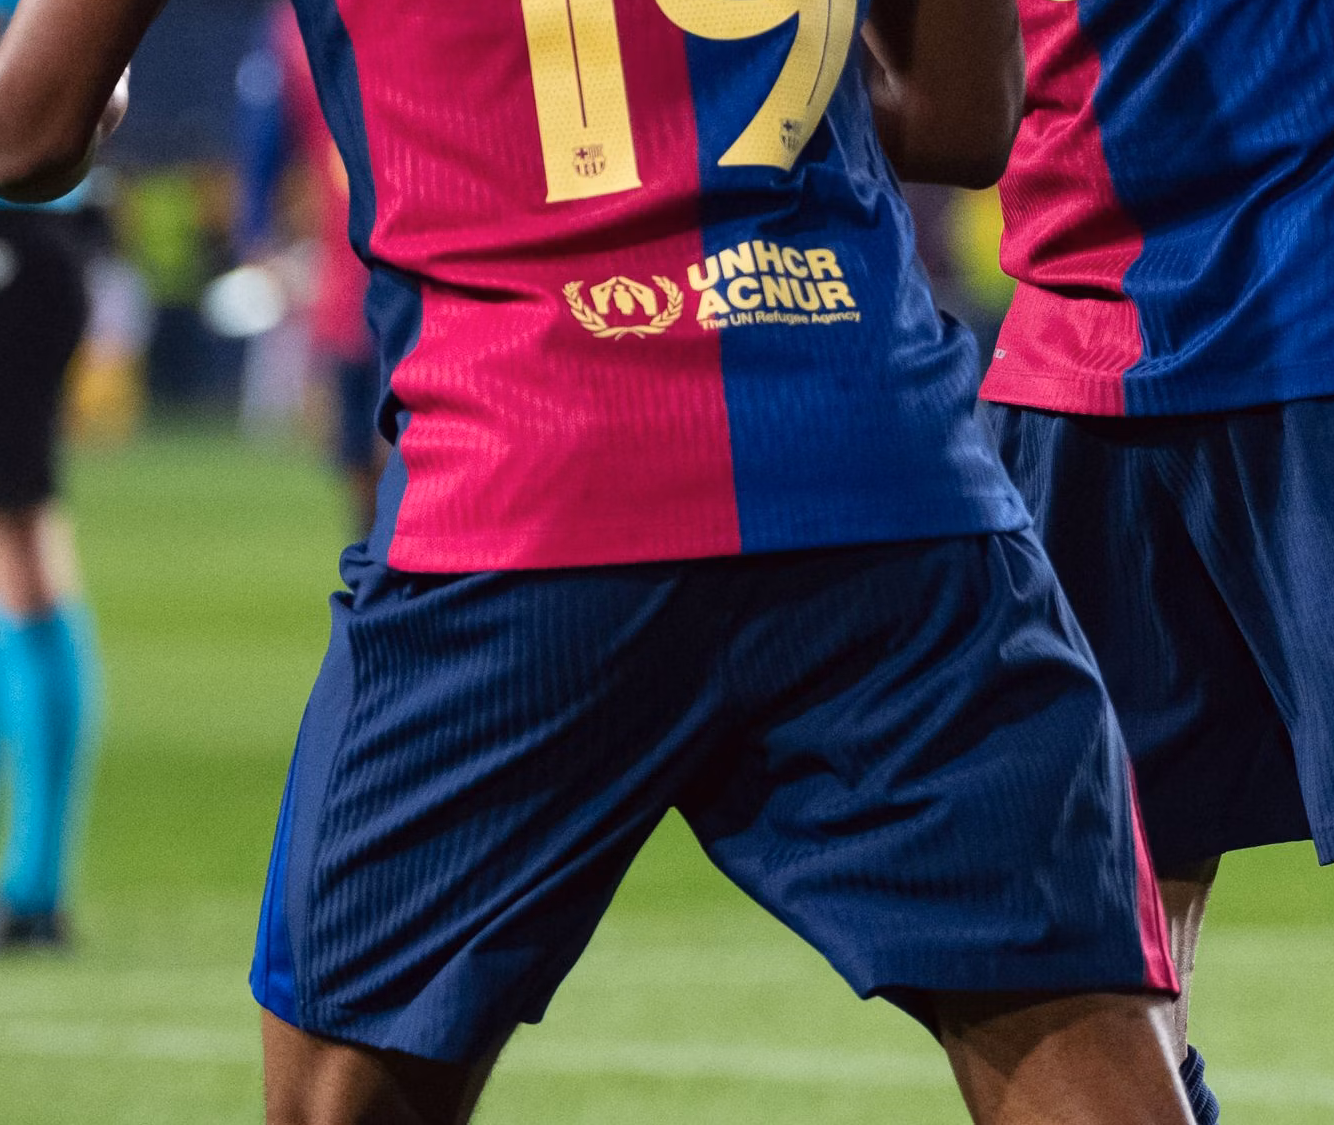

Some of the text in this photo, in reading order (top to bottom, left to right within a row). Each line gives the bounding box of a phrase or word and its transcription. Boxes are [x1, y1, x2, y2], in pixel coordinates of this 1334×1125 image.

[686, 239, 844, 292] UNHCR
[696, 274, 857, 322] ACNUR
[699, 310, 862, 331] The UN Refugee Agency
